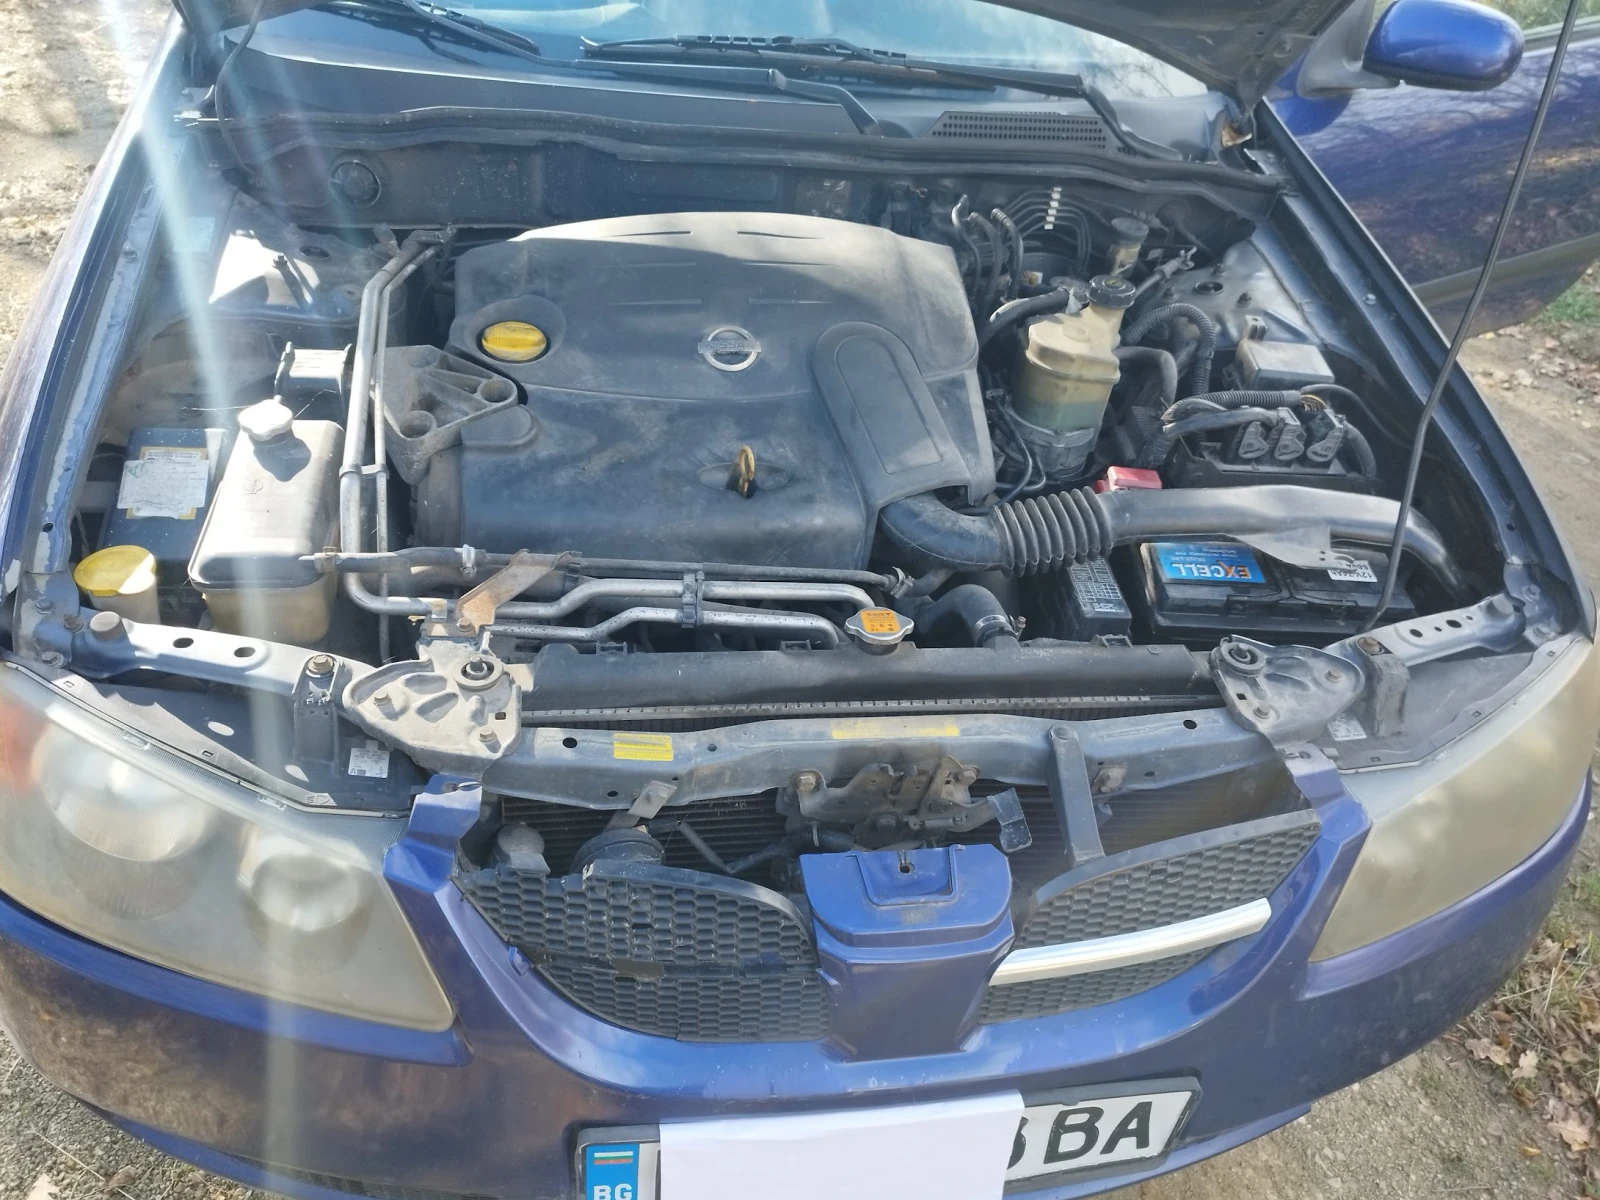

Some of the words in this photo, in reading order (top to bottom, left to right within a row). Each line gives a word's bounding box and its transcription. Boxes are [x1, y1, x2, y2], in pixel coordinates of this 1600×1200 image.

[1171, 560, 1252, 579] EXCELL
[1044, 1101, 1153, 1164] BA
[593, 1183, 632, 1200] BG
